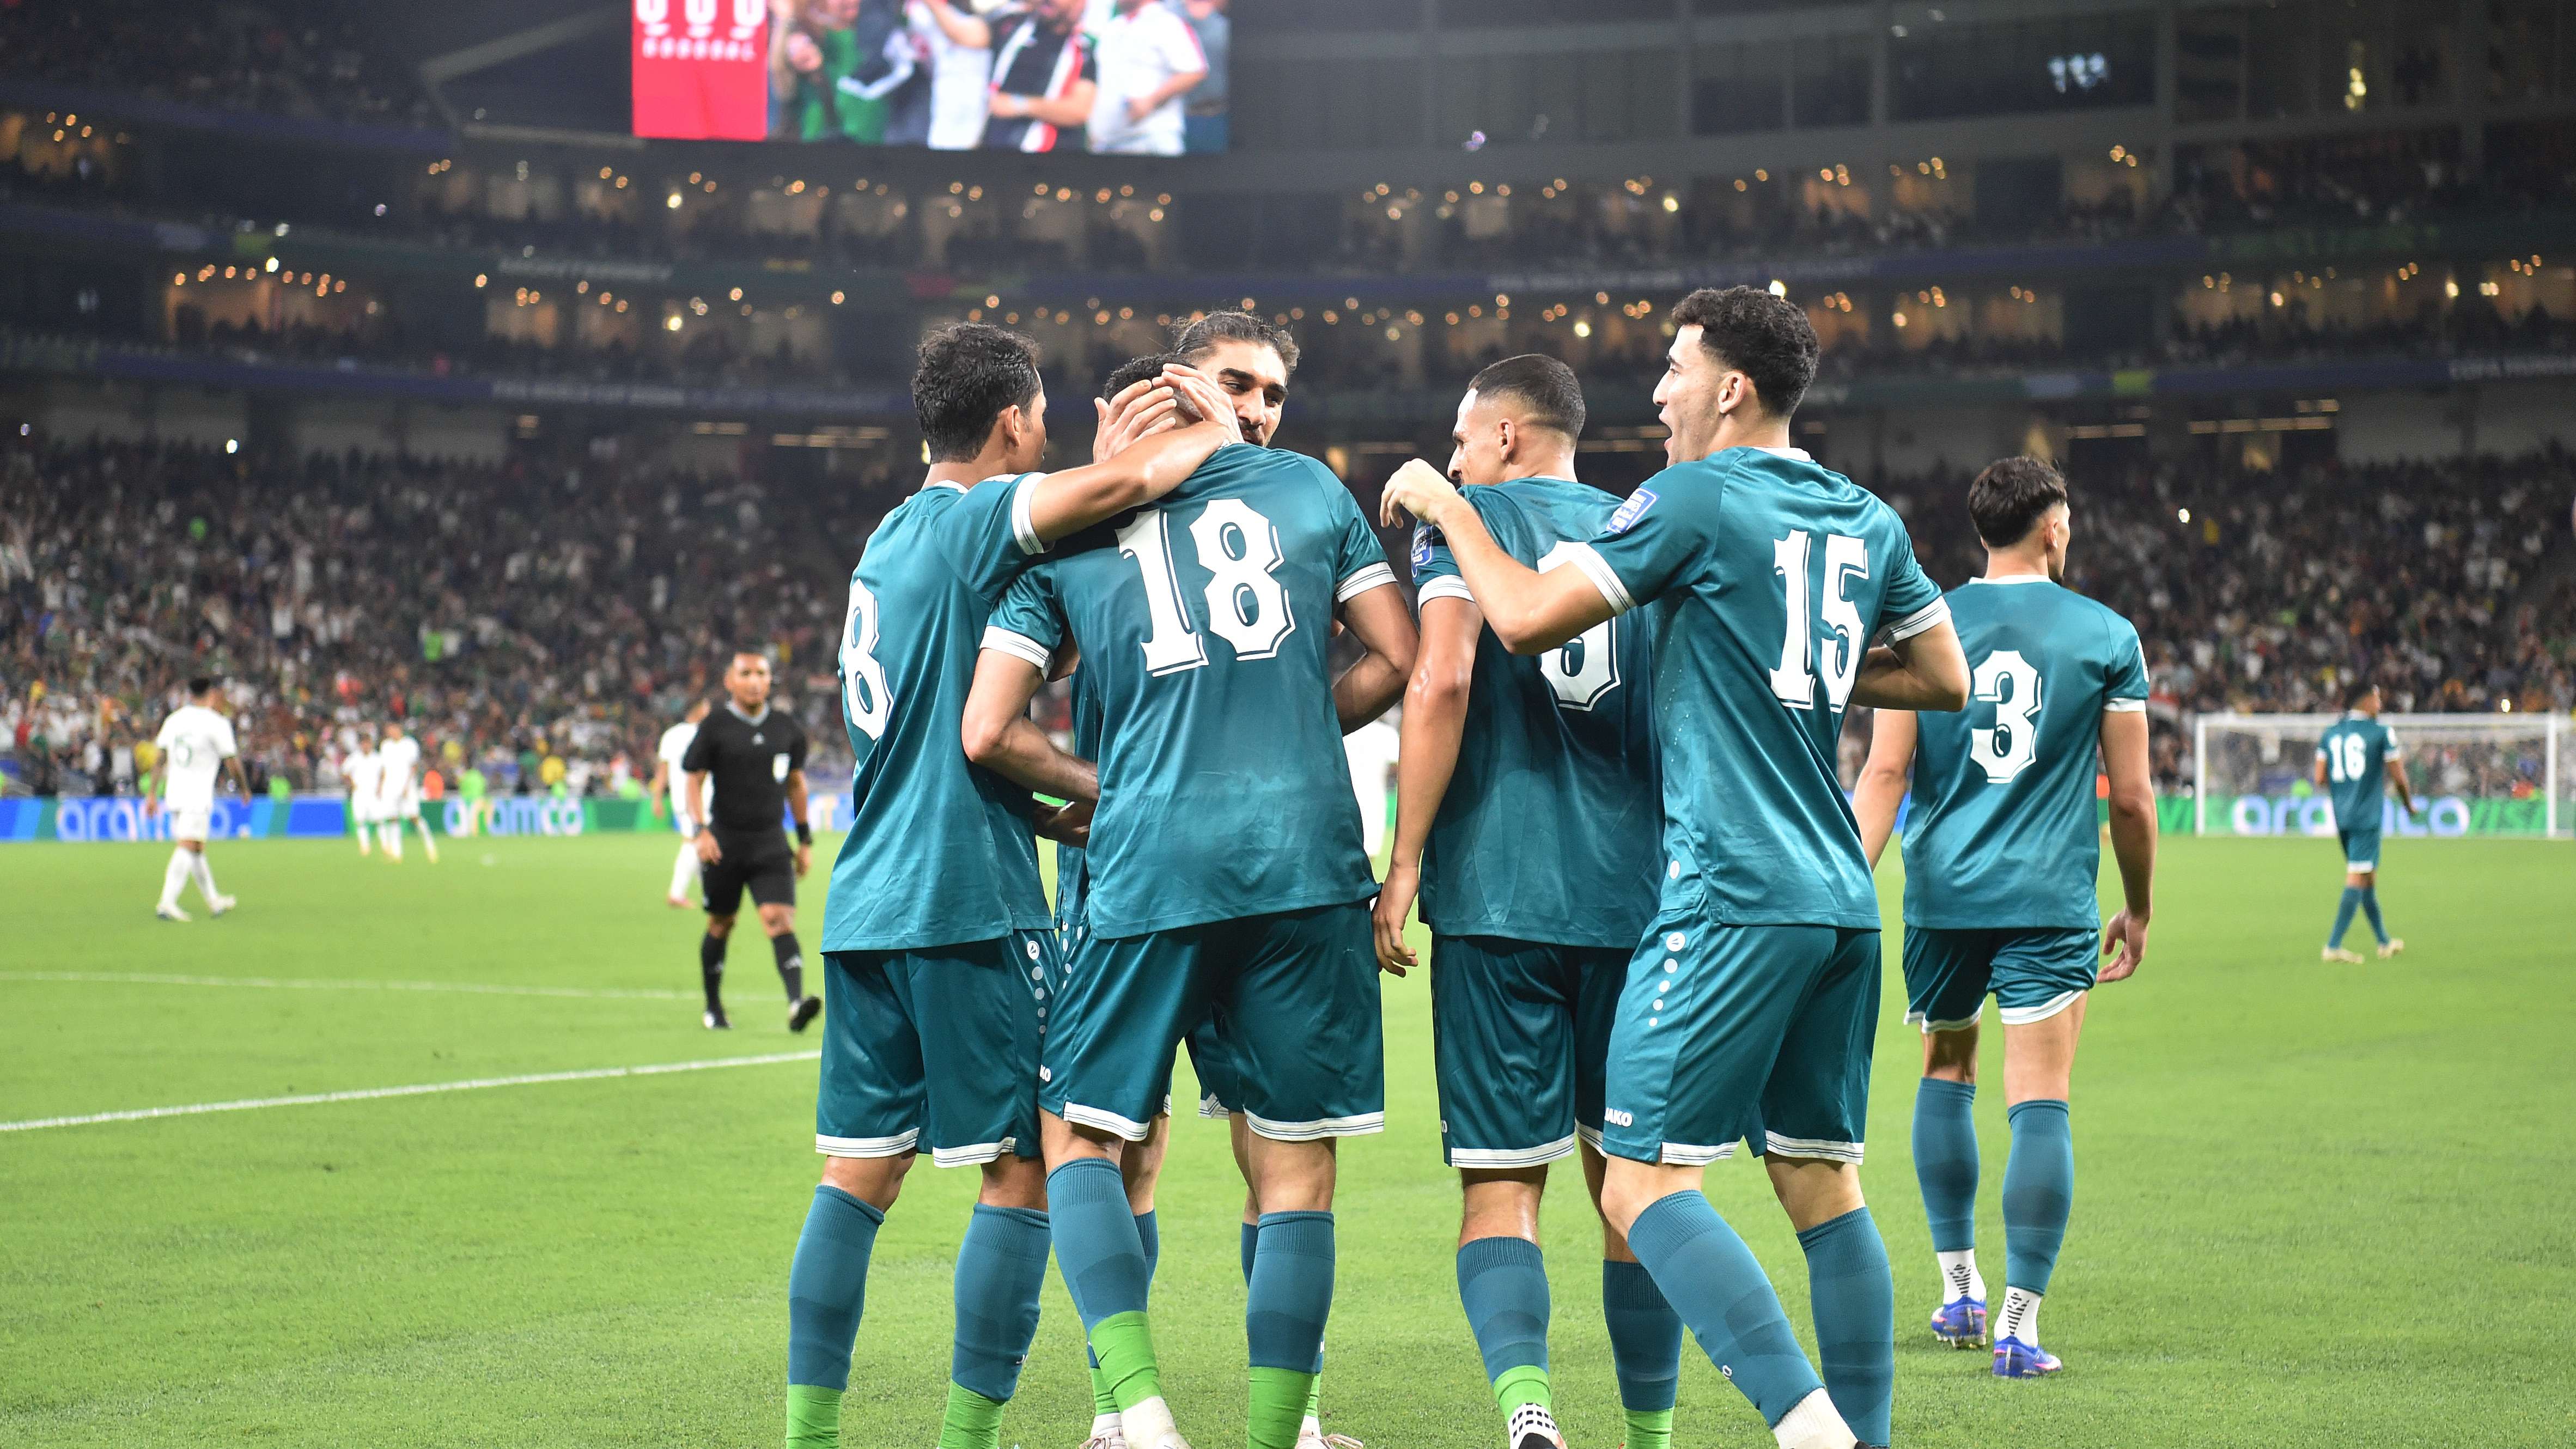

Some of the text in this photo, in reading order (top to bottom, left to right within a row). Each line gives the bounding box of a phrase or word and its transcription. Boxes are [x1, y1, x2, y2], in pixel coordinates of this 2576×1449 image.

[1115, 498, 1296, 677] 18
[1769, 529, 1869, 713] 15
[841, 578, 894, 740] 8
[1970, 650, 2042, 783] 3
[2329, 733, 2366, 783] 16
[57, 797, 232, 840] aramo
[443, 796, 582, 836] aramco
[2233, 795, 2470, 837] araco
